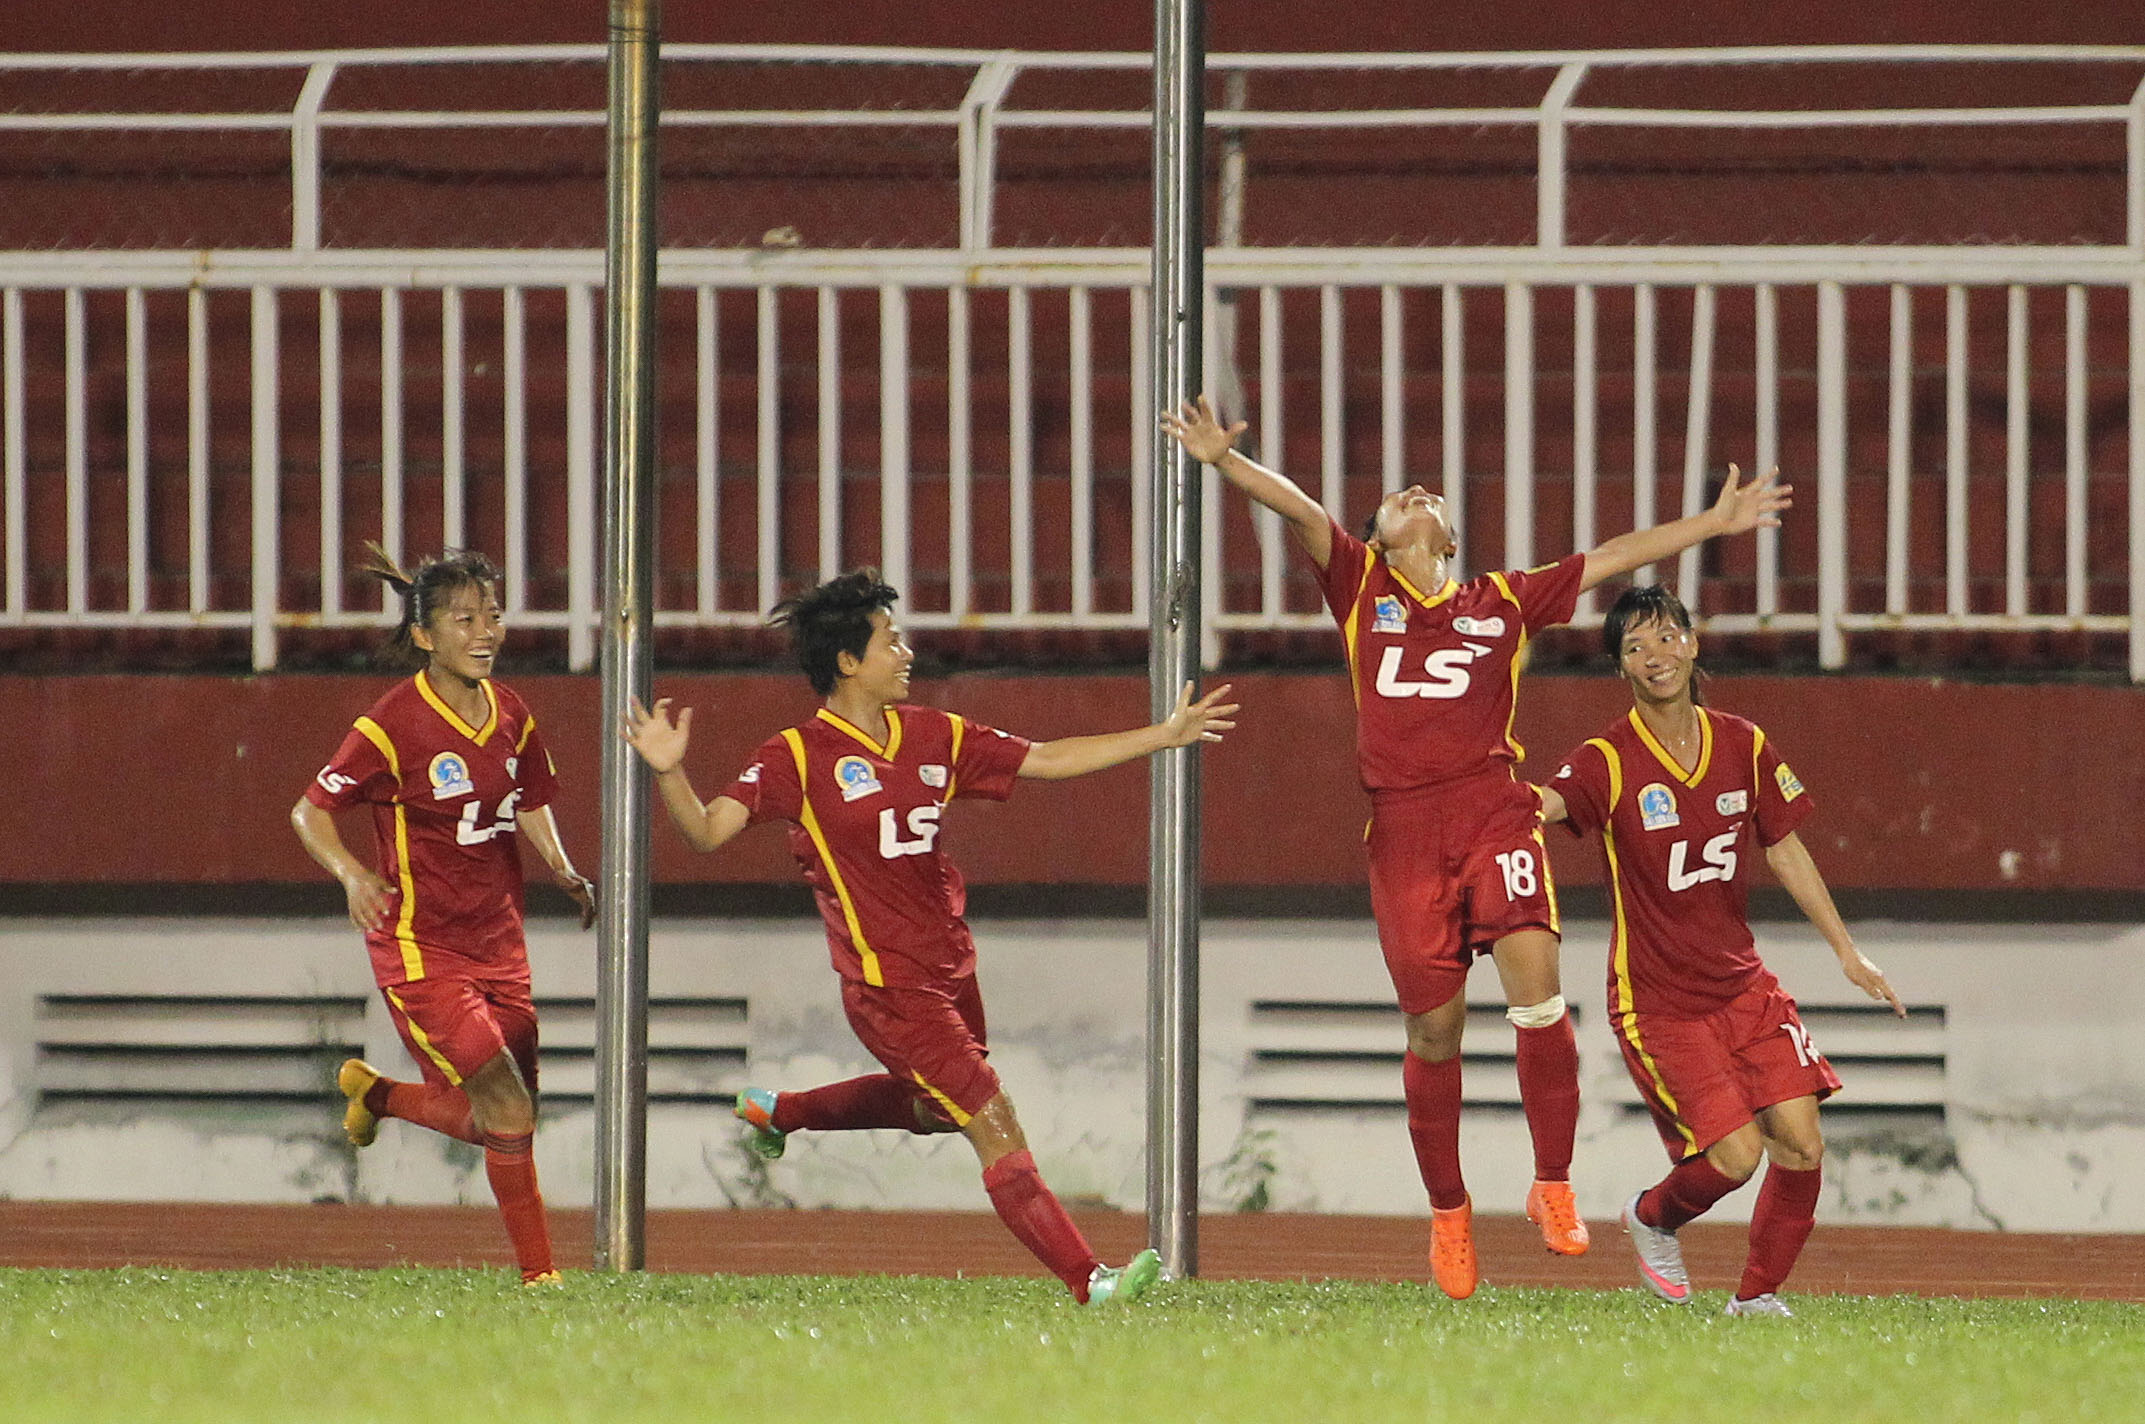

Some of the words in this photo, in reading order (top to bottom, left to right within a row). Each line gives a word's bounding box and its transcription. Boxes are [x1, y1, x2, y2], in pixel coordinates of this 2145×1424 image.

[1376, 646, 1476, 699] LS
[879, 805, 941, 860] LS
[1495, 848, 1537, 902] 18
[1667, 831, 1738, 892] LS
